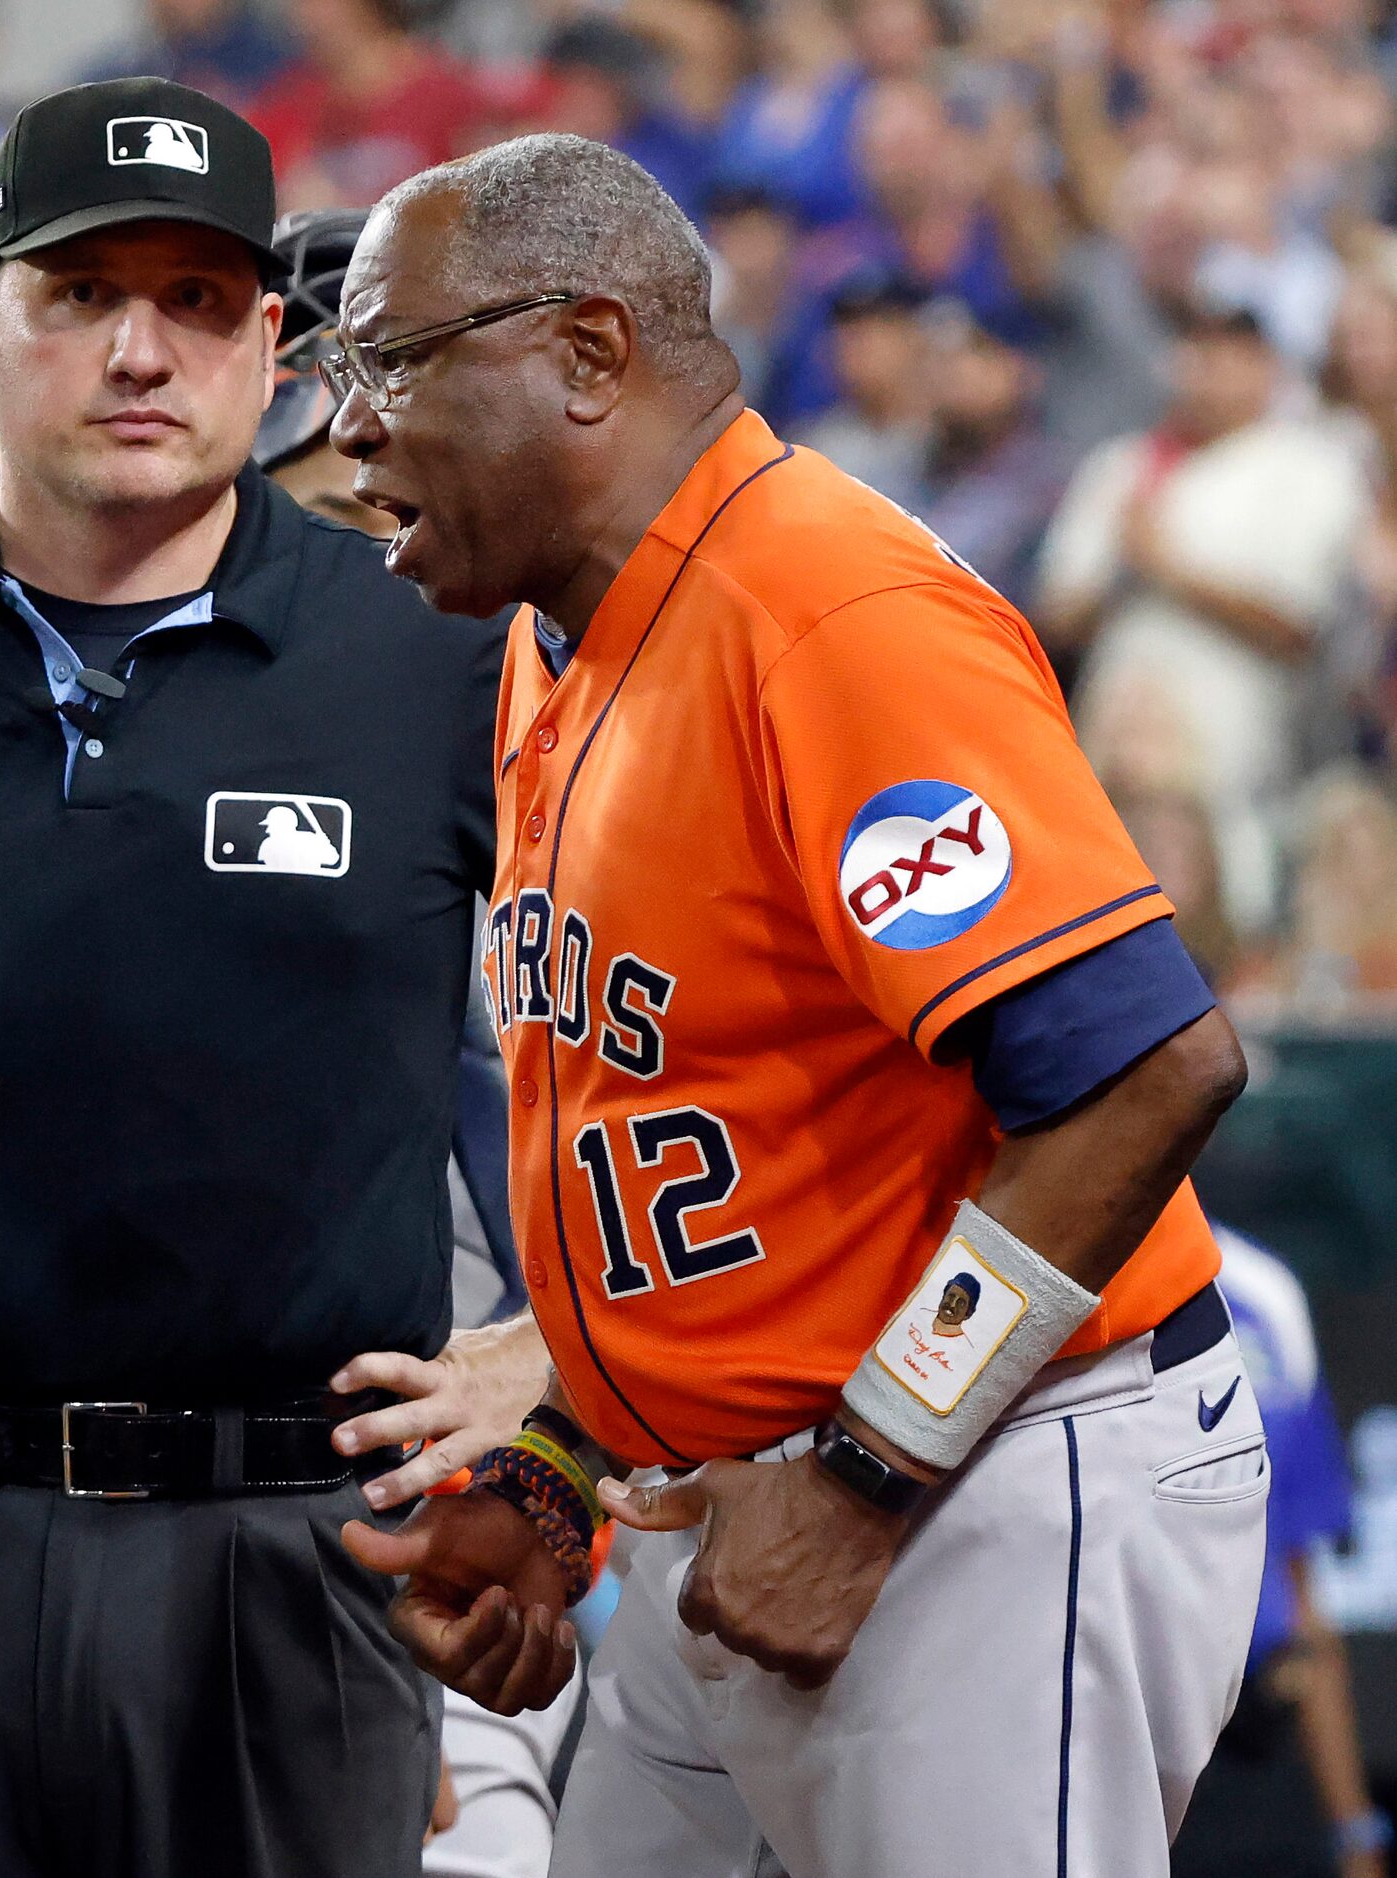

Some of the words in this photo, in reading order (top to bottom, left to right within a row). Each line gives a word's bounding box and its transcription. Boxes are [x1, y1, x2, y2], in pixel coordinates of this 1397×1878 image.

[848, 805, 985, 925] OXY
[481, 888, 676, 1081] TROS
[573, 1105, 766, 1300] 12
